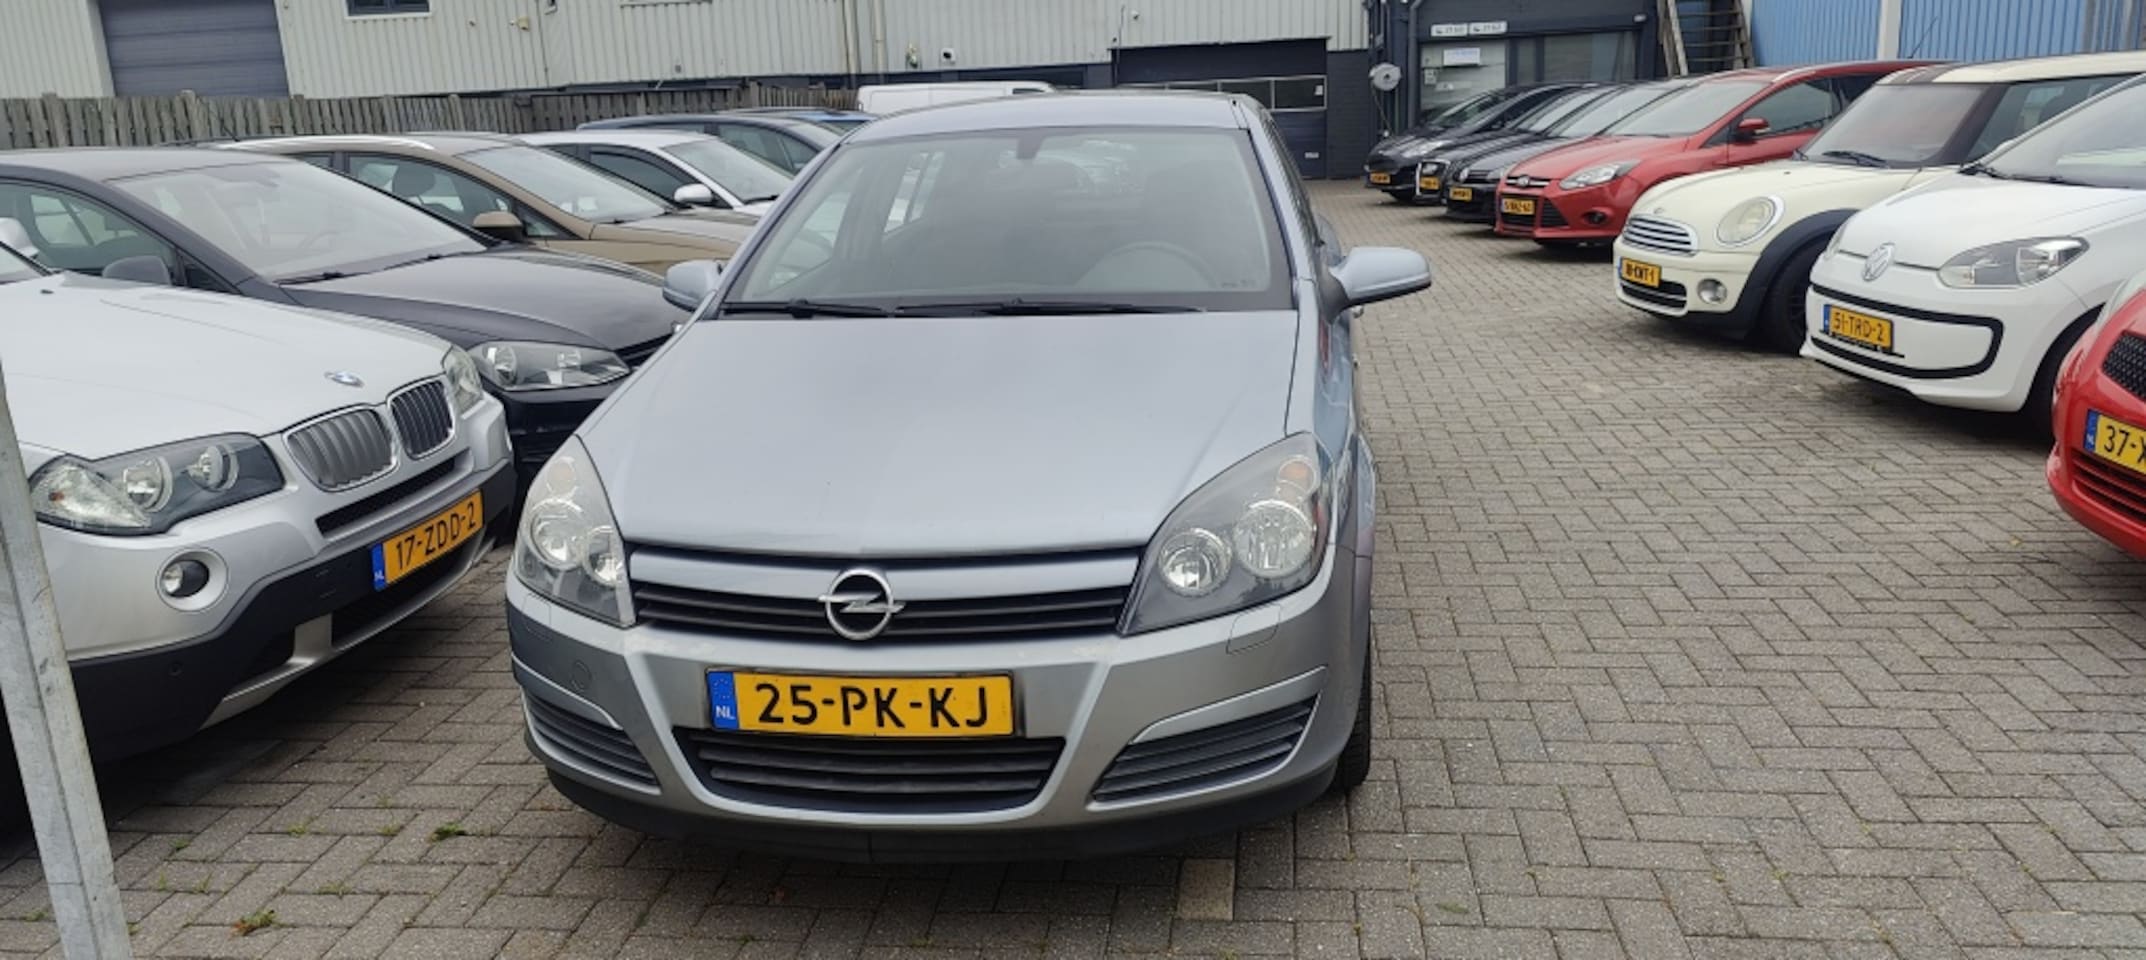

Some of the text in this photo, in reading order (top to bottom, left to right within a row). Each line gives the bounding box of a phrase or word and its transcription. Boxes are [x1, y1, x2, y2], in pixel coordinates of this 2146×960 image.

[1833, 312, 1885, 342] 51-TRD-2
[396, 501, 476, 570] 17-ZDD-2
[715, 683, 988, 728] NL 25-PK-KJ
